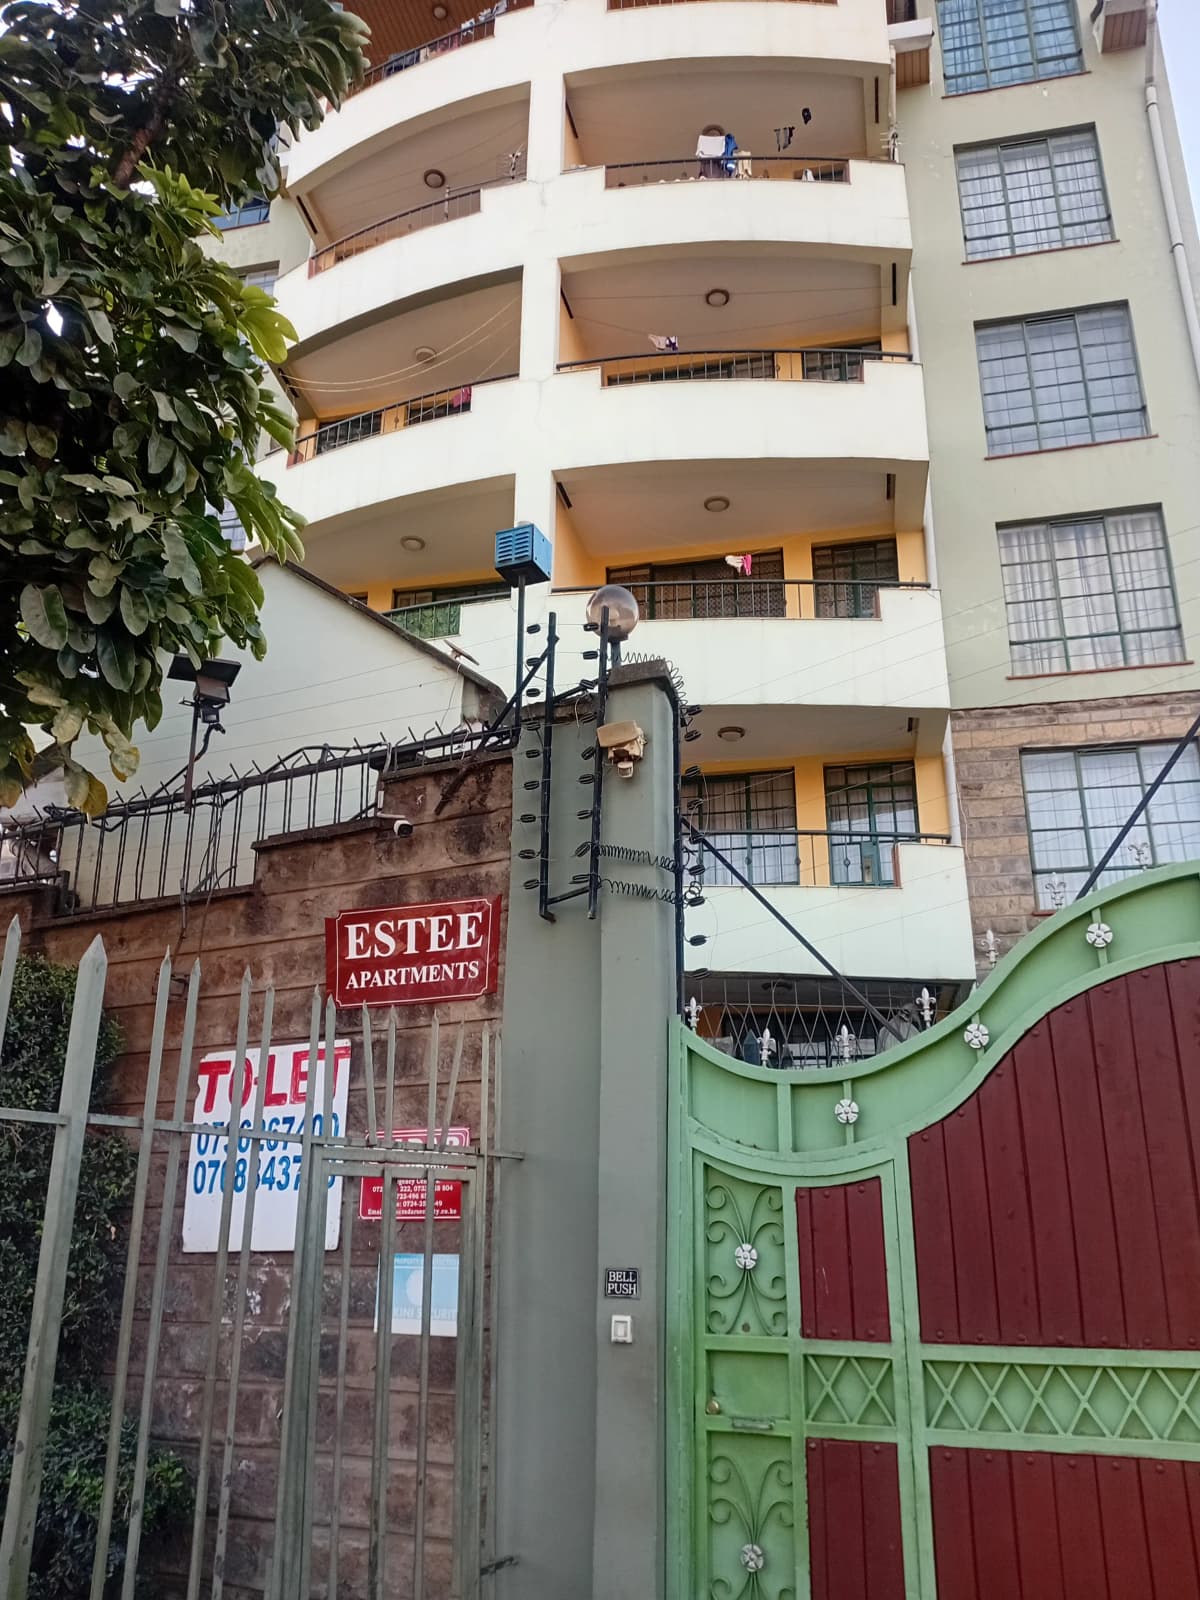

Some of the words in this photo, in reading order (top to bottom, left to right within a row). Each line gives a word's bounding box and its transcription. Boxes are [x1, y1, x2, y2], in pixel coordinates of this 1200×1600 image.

[344, 911, 484, 960] ESTEE
[345, 960, 480, 990] APARTMENTS
[608, 1271, 637, 1282] BELL
[607, 1283, 637, 1295] PUSH
